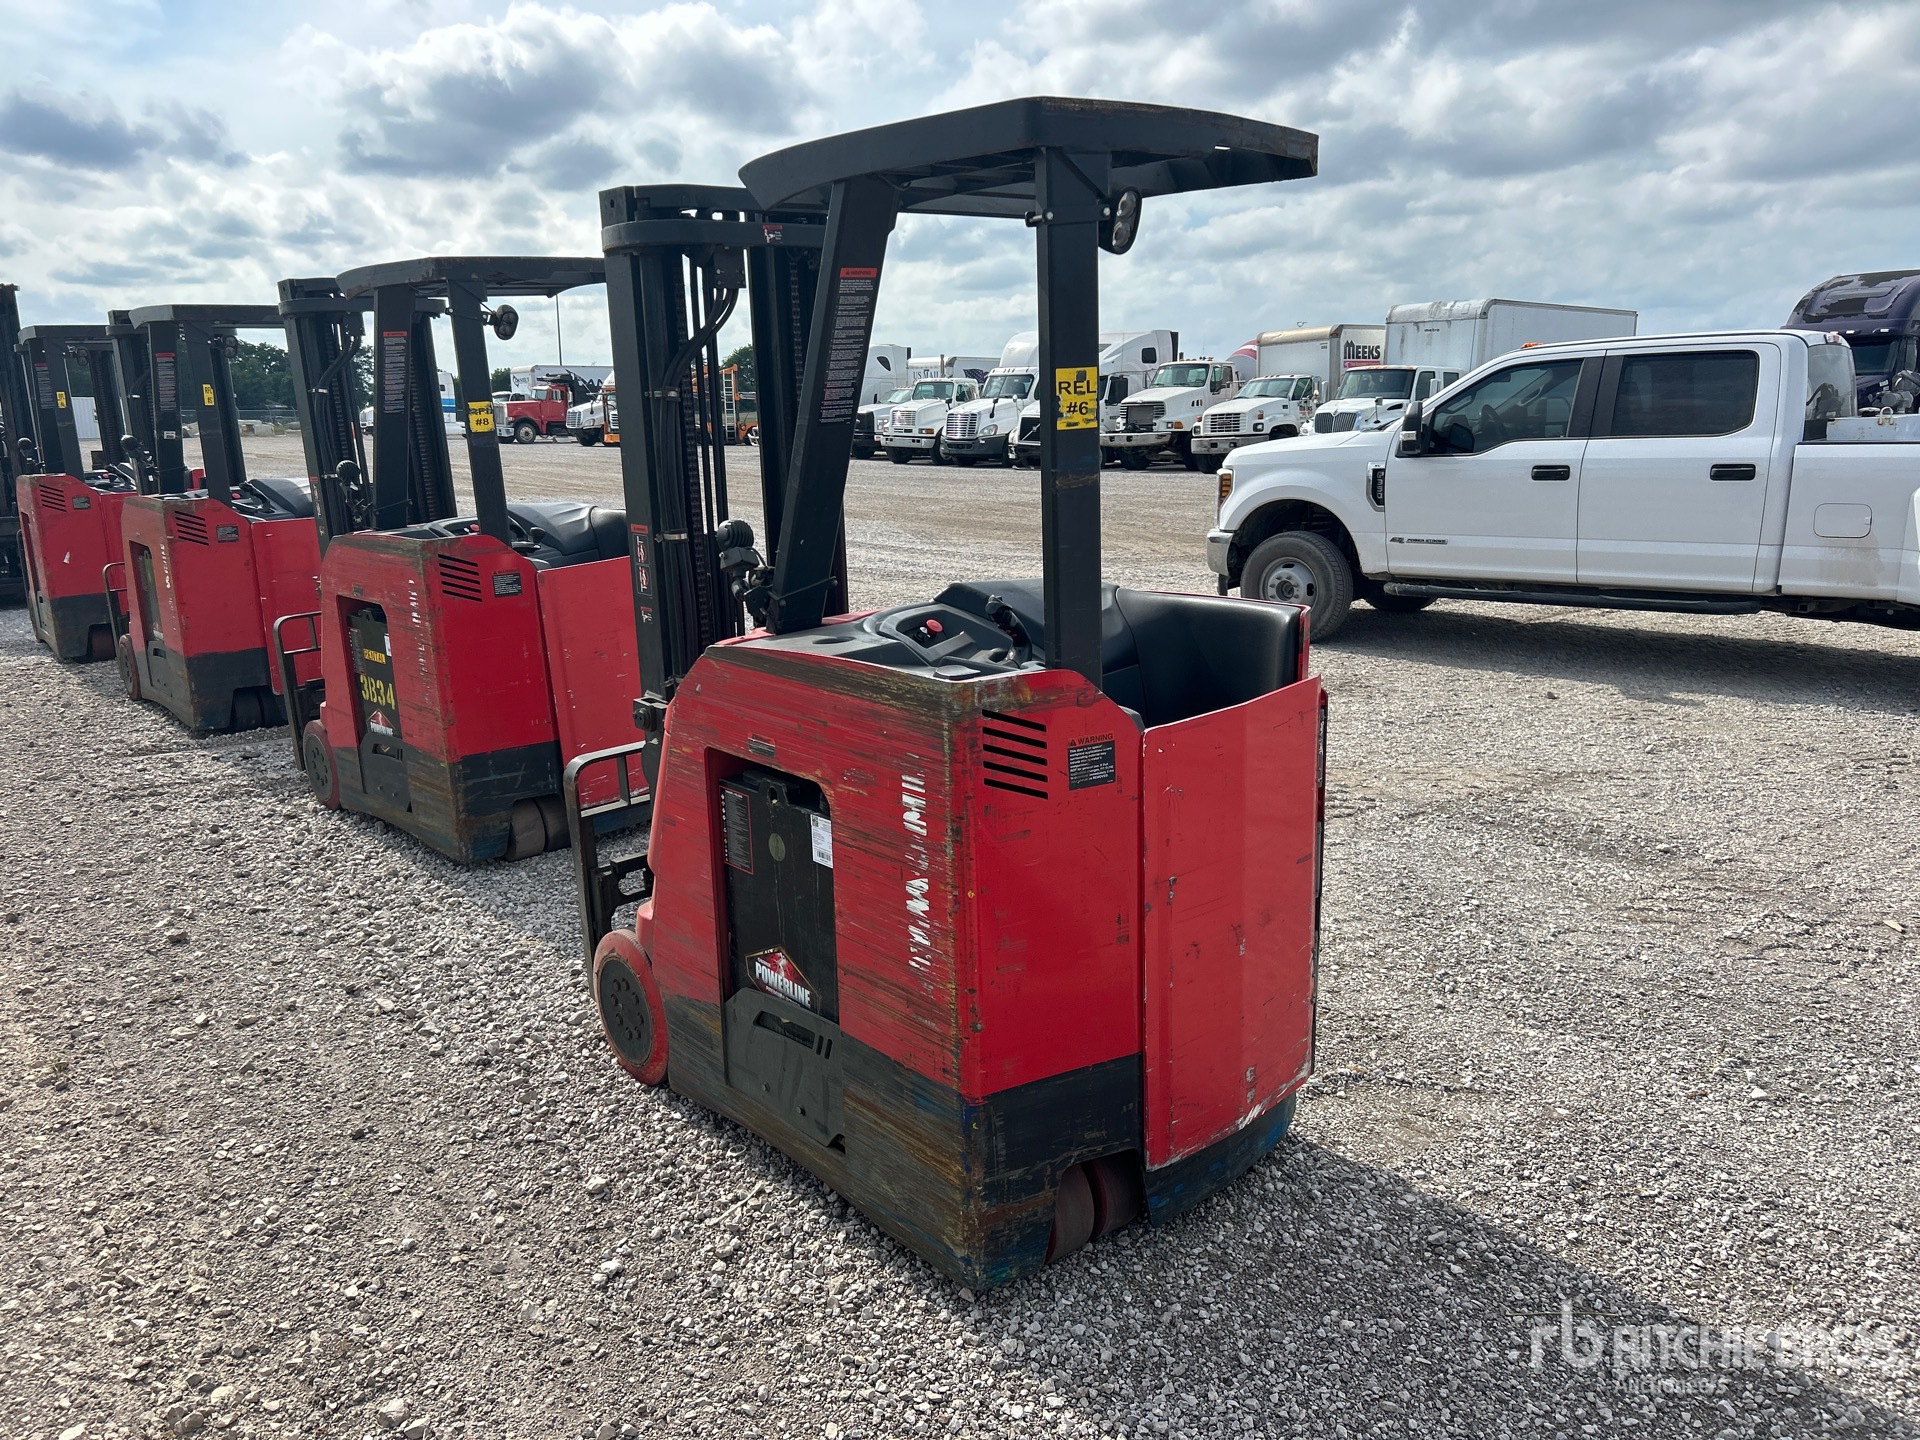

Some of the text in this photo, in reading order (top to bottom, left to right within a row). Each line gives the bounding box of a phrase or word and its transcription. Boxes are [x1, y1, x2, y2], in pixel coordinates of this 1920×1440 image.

[1343, 340, 1381, 360] MEEKS
[1057, 379, 1097, 395] REL
[1066, 401, 1089, 416] #6
[475, 417, 490, 426] #8
[1078, 732, 1113, 745] WARNING
[755, 961, 811, 1009] POWERLINE
